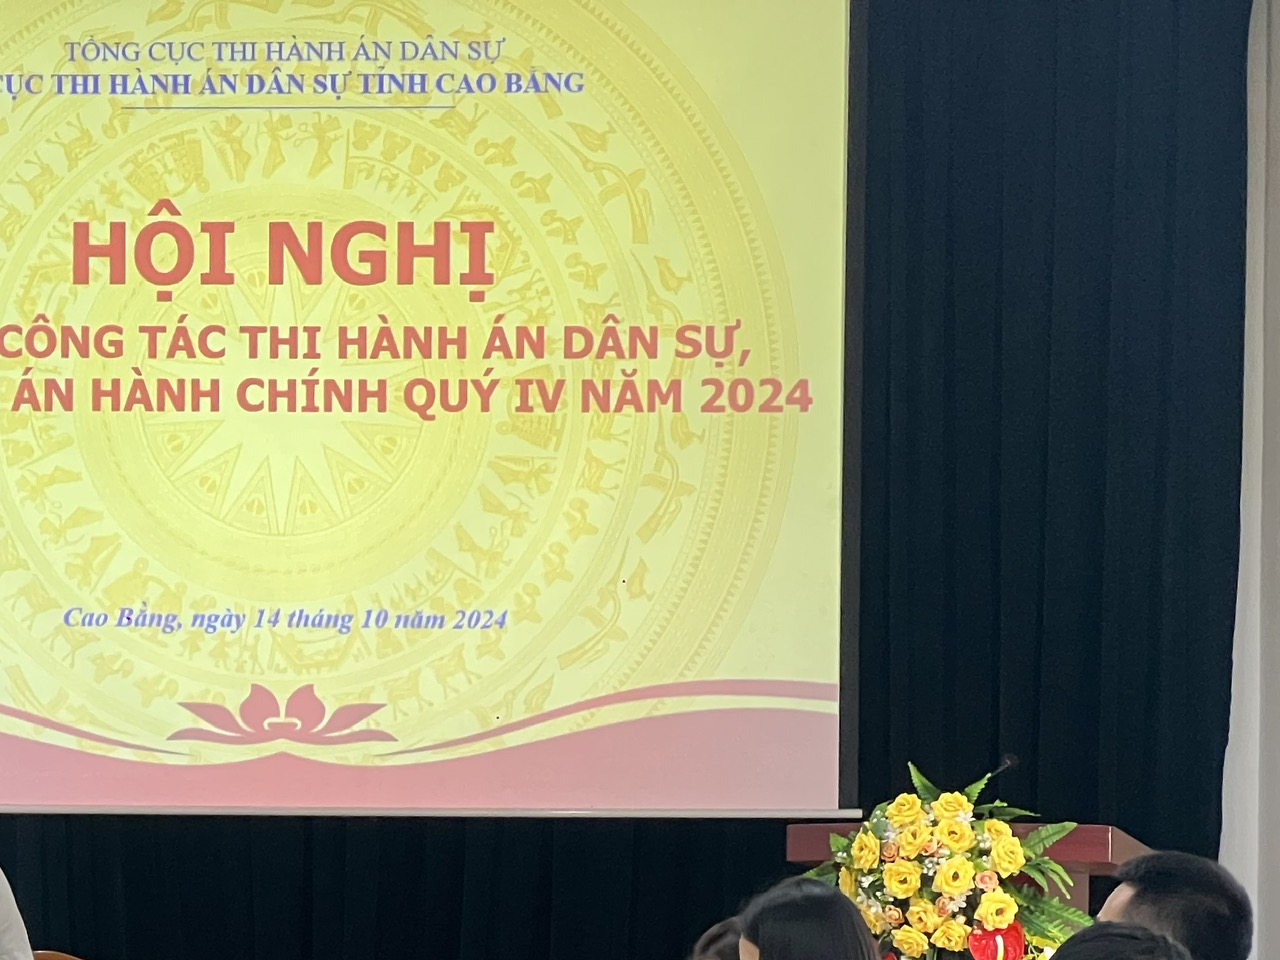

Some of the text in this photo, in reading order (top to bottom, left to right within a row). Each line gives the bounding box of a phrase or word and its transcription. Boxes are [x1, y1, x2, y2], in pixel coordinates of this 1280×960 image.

[64, 34, 507, 66] TỔNG CỤC THI HÀNH ÁN DÂN SỰ
[50, 73, 101, 95] THI
[108, 68, 192, 95] HÀNH
[198, 68, 238, 95] ÁN
[245, 66, 305, 95] DÂN
[312, 71, 353, 101] SỰ
[357, 66, 427, 94] TỈNH
[434, 72, 497, 94] CAO
[73, 198, 496, 303] HỘI NGHỊ
[138, 314, 226, 359] TÁC
[239, 325, 321, 359] THI
[338, 315, 468, 359] HÀNH
[483, 315, 546, 359] ÁN
[563, 314, 660, 359] DÂN
[675, 319, 751, 369] SỰ,
[12, 367, 75, 412] ÁN
[91, 368, 221, 412] HÀNH
[236, 368, 388, 413] CHÍNH
[403, 367, 500, 421] QUÝ
[515, 379, 568, 413] IV
[581, 369, 682, 413] NĂM
[700, 378, 813, 413] 2024
[63, 600, 508, 635] Cao Bằng, ngày 14 tháng 10 năm 2024
